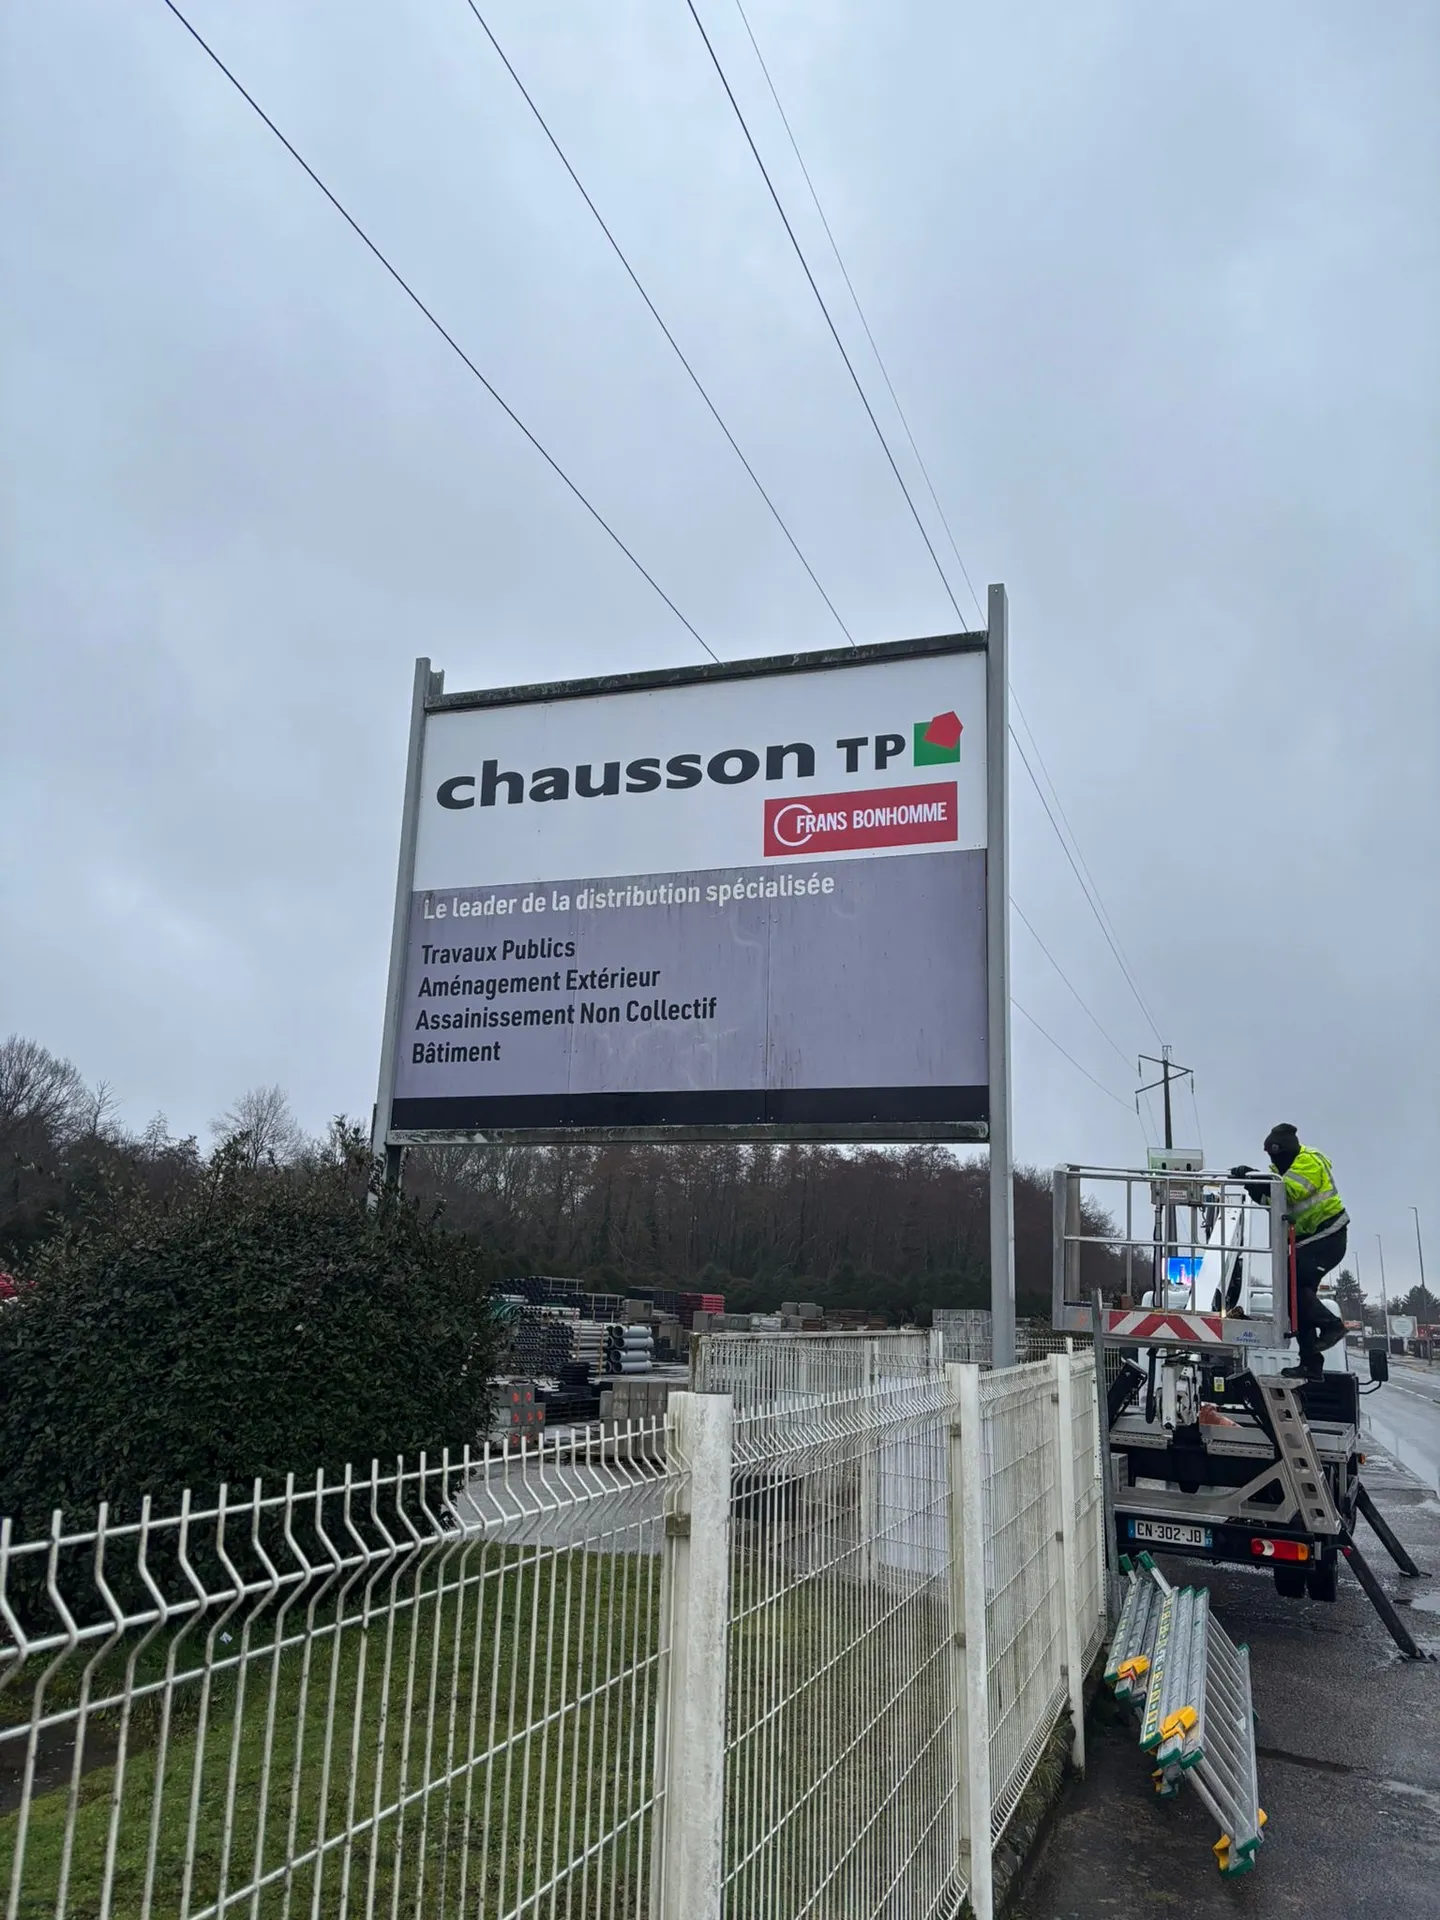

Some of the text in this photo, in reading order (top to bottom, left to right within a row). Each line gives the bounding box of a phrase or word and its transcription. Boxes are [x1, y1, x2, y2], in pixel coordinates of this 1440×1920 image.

[436, 733, 906, 810] chausson TP
[796, 801, 948, 834] FRANS BONHOMME
[424, 872, 835, 920] Le leader de la distribution spécialisée
[422, 937, 576, 965] Travaux Publics
[418, 967, 661, 1000] Aménagement Extérieur
[415, 997, 717, 1030] Assainissement Non Collectif
[412, 1041, 501, 1064] Bâtiment
